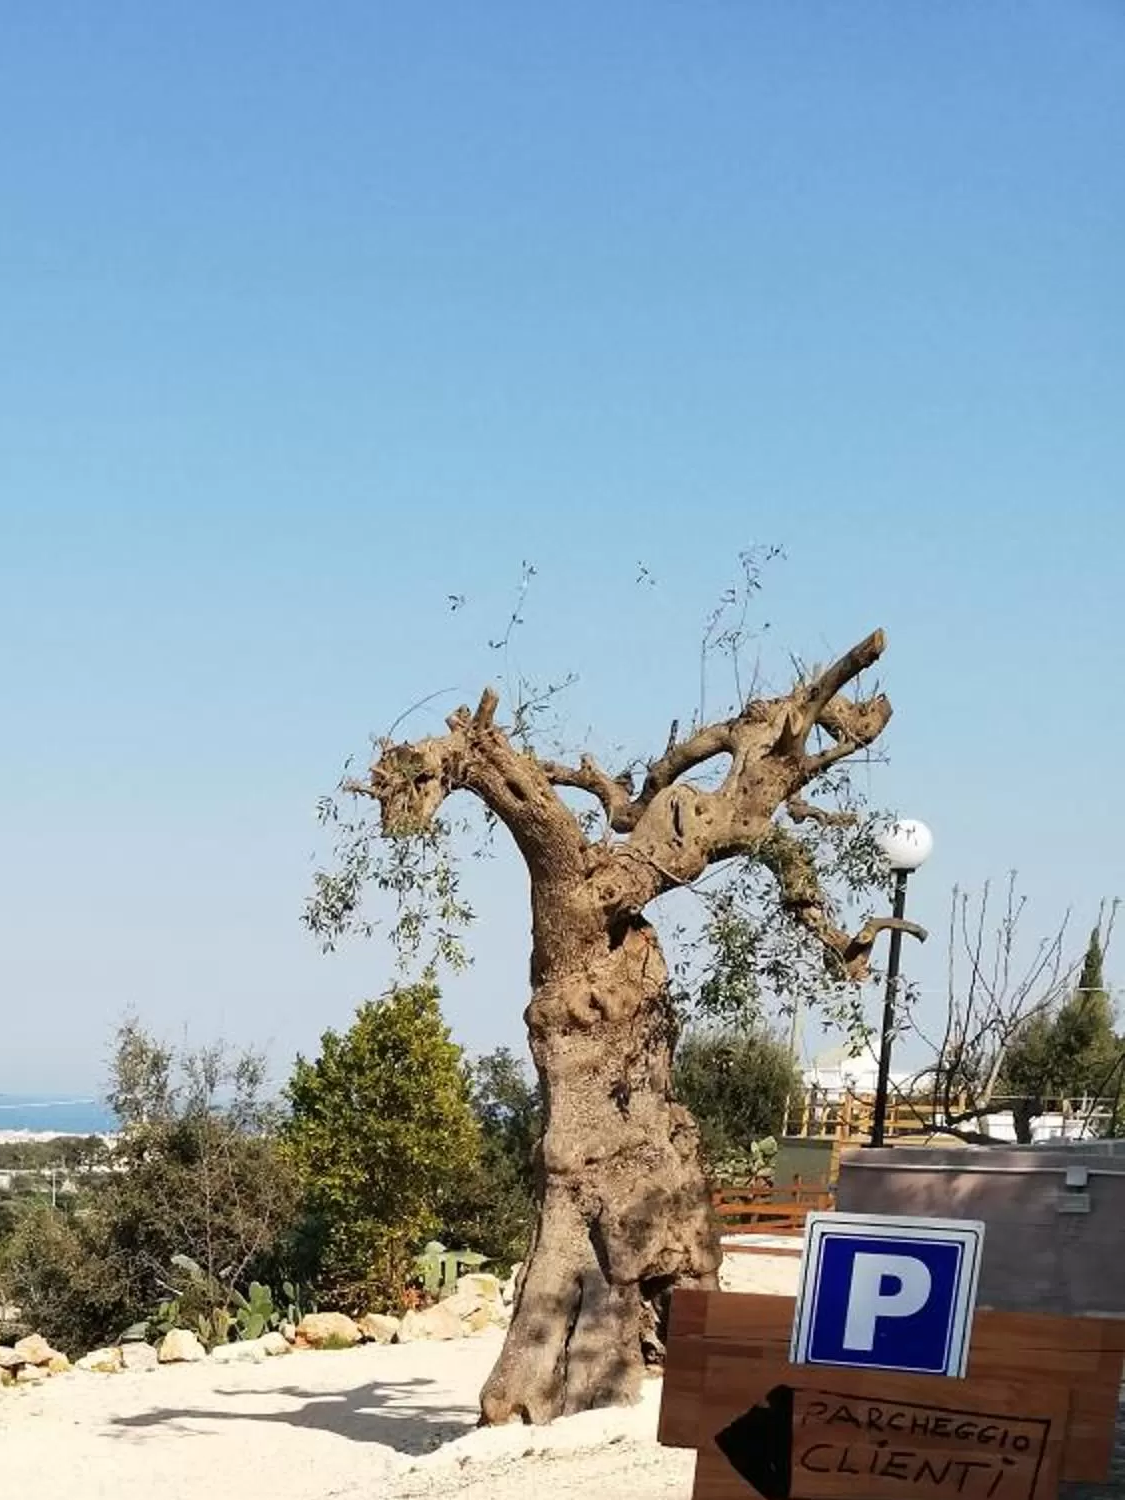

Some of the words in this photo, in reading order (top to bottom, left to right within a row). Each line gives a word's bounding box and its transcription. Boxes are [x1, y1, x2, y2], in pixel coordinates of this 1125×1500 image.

[842, 1251, 932, 1351] P
[800, 1401, 1030, 1453] PARCHEGGIO
[800, 1440, 1016, 1499] CLIENTI
